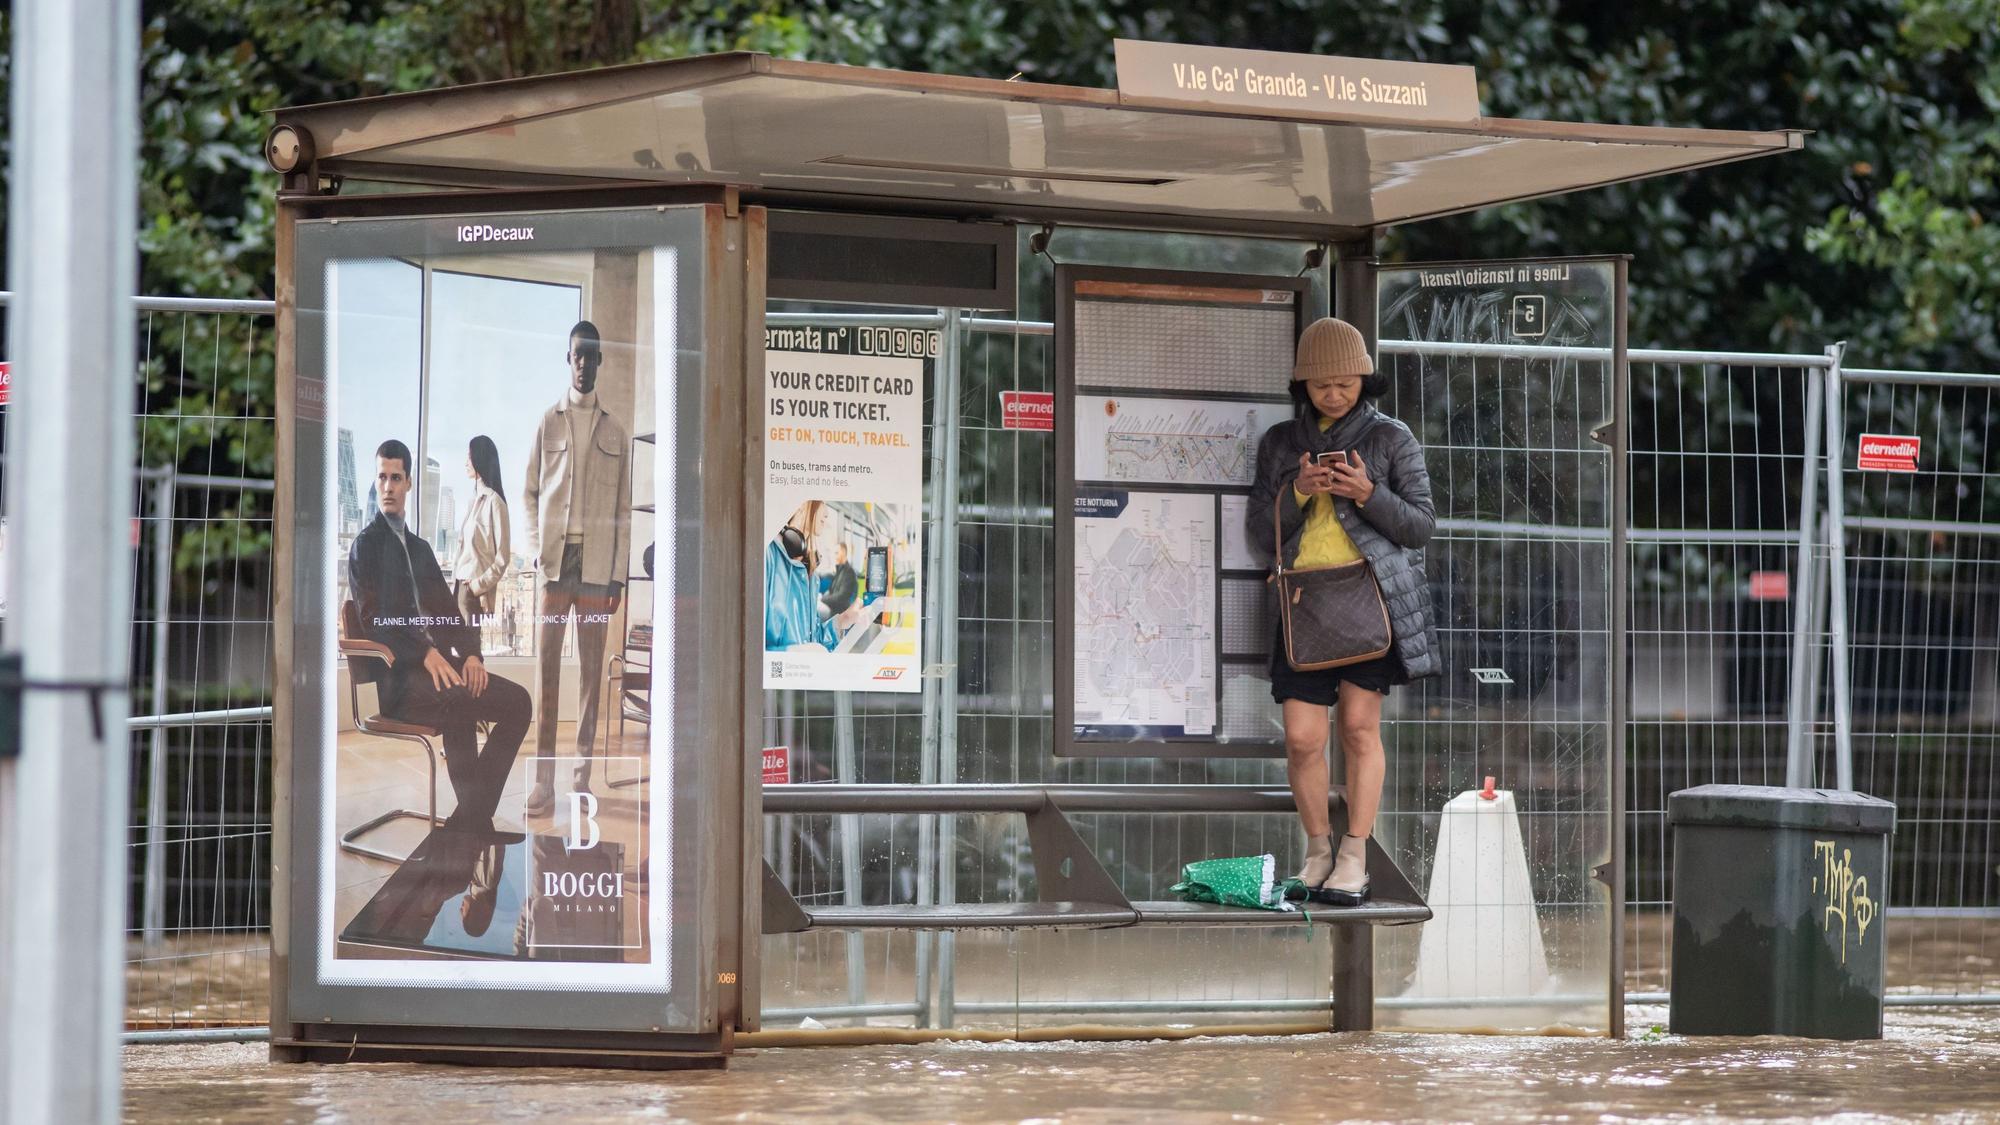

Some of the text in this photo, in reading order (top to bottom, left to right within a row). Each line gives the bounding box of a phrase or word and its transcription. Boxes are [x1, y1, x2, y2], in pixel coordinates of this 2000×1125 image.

[1172, 62, 1207, 90] V.le
[1211, 65, 1239, 93] Ca'
[1245, 68, 1307, 98] Granda
[1323, 74, 1356, 101] V.le
[1361, 77, 1427, 107] Suzzani
[457, 225, 534, 242] IGPDecaux
[827, 328, 847, 350] n°
[861, 330, 939, 355] 11966
[770, 370, 913, 396] YOUR CREDIT CARD
[770, 398, 890, 422] IS YOUR TICKET.
[770, 427, 911, 448] GET ON, TOUCH, TRAVEL.
[1863, 443, 1916, 456] eternedile
[770, 460, 873, 474] On buses, trams and metro.
[770, 474, 789, 486] Easy,
[790, 475, 805, 485] fast
[806, 476, 820, 486] and
[821, 478, 831, 486] no
[373, 617, 407, 627] FLANNEL
[408, 616, 435, 625] MEETS
[436, 616, 460, 625] STYLE
[583, 614, 612, 623] JACKET
[566, 792, 600, 850] B
[543, 871, 624, 898] BOGGI
[553, 904, 616, 913] MILANO
